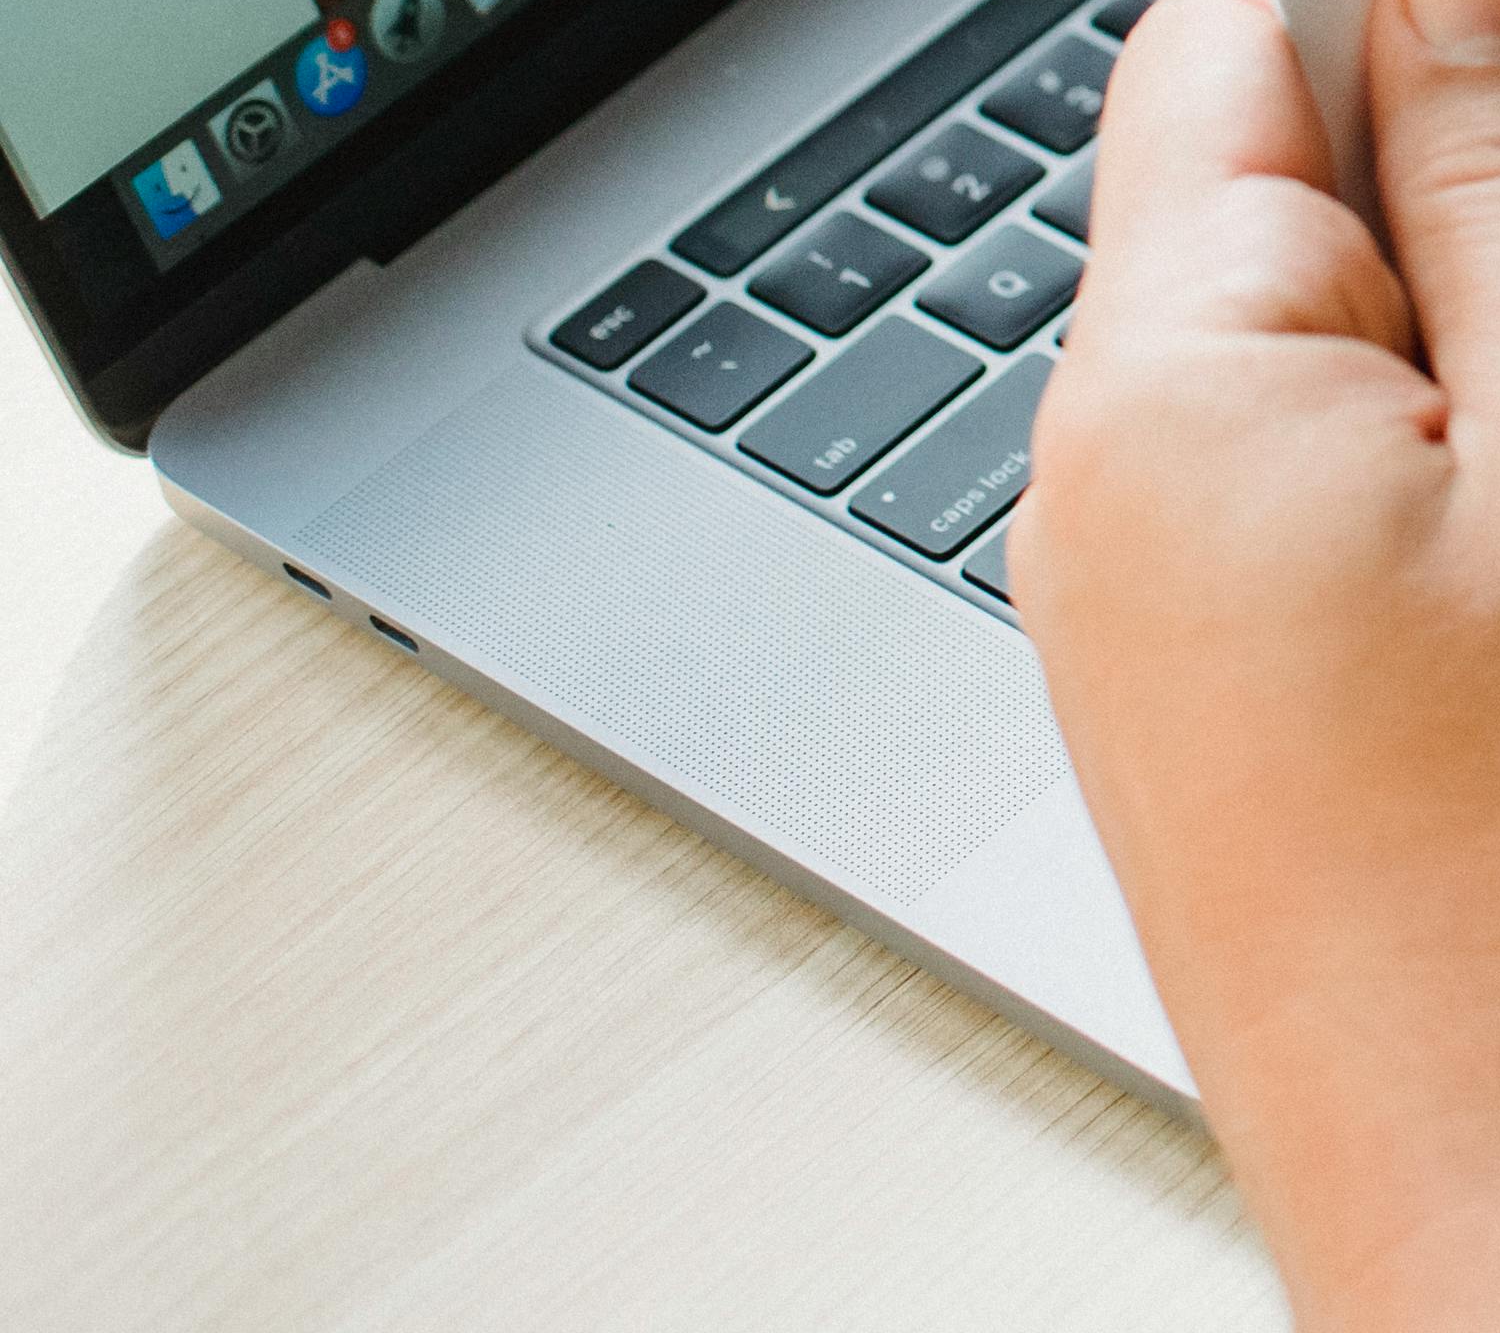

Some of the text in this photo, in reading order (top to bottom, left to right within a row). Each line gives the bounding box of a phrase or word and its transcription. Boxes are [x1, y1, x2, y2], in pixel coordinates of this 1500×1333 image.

[951, 172, 992, 202] 2
[588, 304, 635, 341] esc
[813, 437, 857, 470] tab
[930, 448, 1030, 533] caps lock
